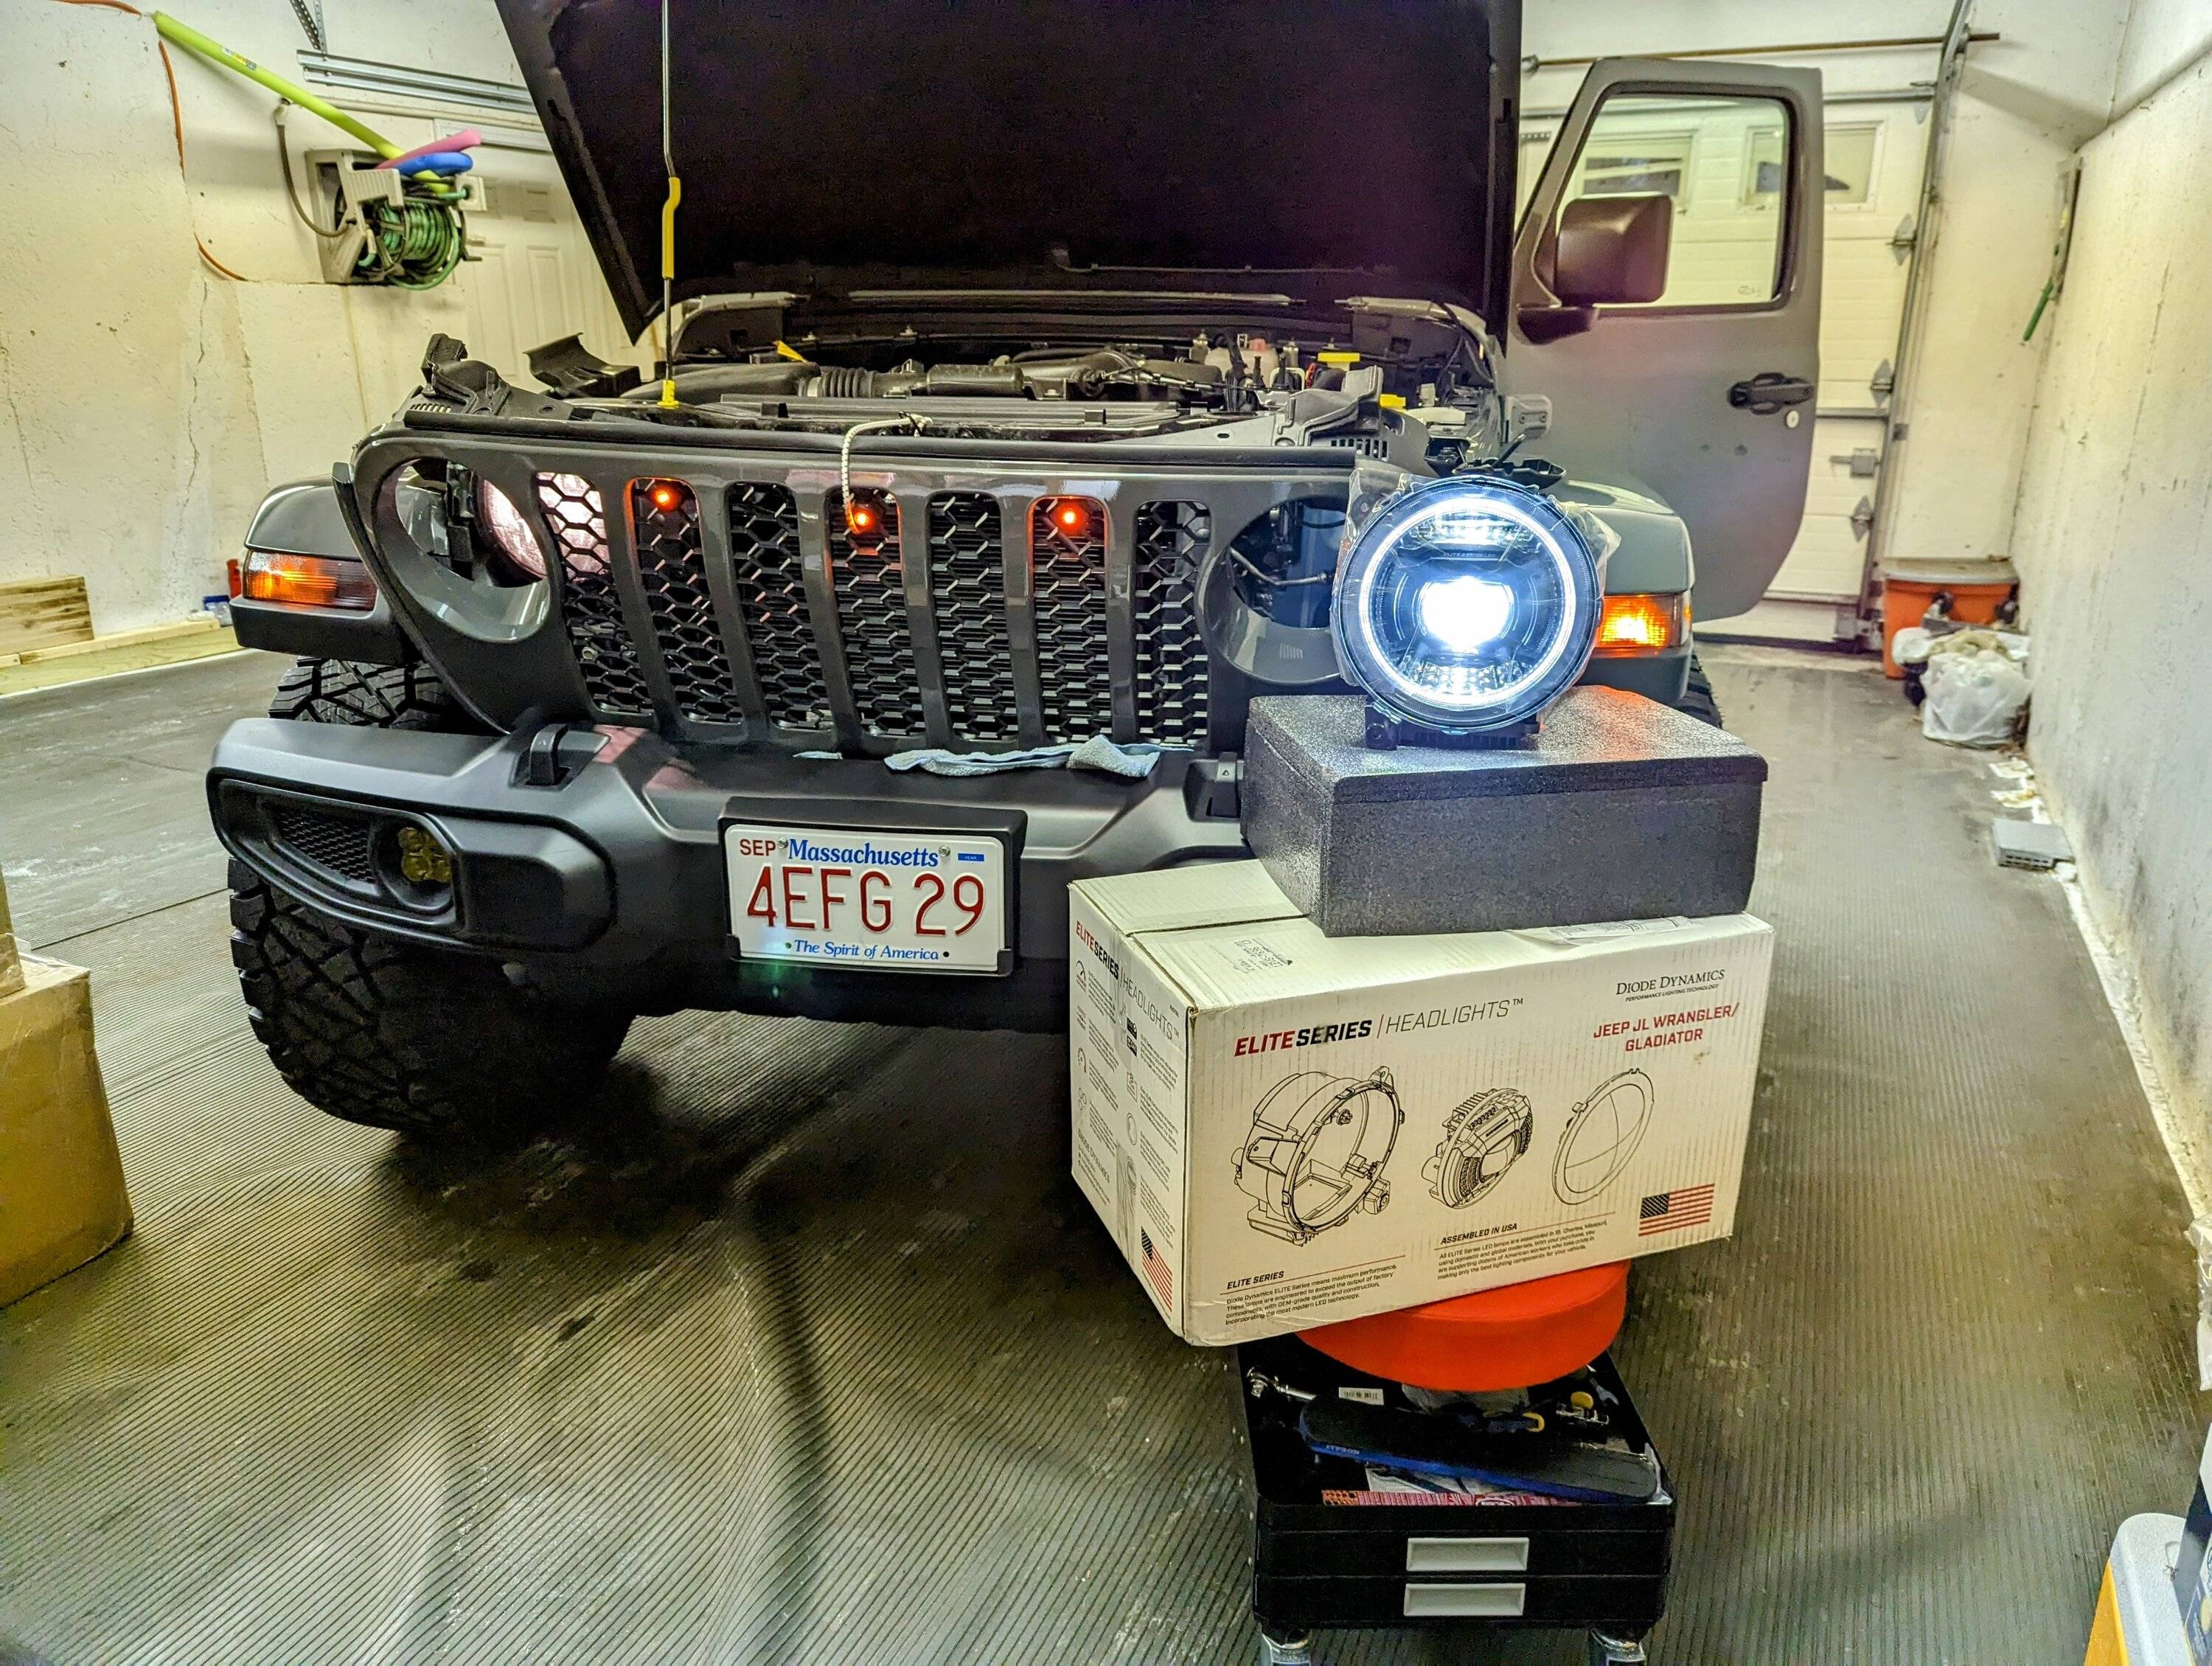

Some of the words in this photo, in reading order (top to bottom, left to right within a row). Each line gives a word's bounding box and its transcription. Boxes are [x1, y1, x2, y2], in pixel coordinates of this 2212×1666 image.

[740, 839, 776, 856] SEP
[788, 839, 939, 867] Massachusetts
[747, 865, 892, 933] 4EFG
[914, 872, 984, 936] 29
[794, 940, 820, 954] The
[824, 941, 860, 959] Spirit
[863, 945, 876, 960] of
[880, 945, 939, 960] America
[1077, 920, 1119, 981] ELITESERIES
[1616, 980, 1657, 995] DIODE
[1660, 969, 1725, 988] DYNAMICS
[1625, 992, 1661, 1002] PERFORMANCE
[1662, 988, 1686, 996] LIGHTING
[1686, 984, 1719, 993] TECHNOLOGY
[1593, 1021, 1630, 1039] JEEP
[1633, 1018, 1649, 1032] JL
[1654, 1002, 1740, 1029] WRANGLER/
[1625, 1028, 1703, 1052] GLADIATOR
[1440, 1228, 1489, 1244] ASSEMBLED
[1501, 1223, 1517, 1232] USA
[1439, 1258, 1453, 1266] using
[1455, 1253, 1478, 1263] domestic
[1491, 1247, 1506, 1255] global
[1448, 1260, 1477, 1271] supporting
[1227, 1277, 1251, 1289] ELITE
[1253, 1270, 1284, 1283] SERIES
[1438, 1271, 1457, 1280] making
[1493, 1260, 1512, 1268] lighting
[1227, 1296, 1242, 1304] Diode
[1245, 1289, 1273, 1301] Dynamics
[1274, 1285, 1290, 1294] ELITE
[1292, 1282, 1310, 1290] Series
[1311, 1277, 1329, 1286] means
[1332, 1271, 1358, 1282] maximum
[1227, 1302, 1244, 1311] These
[1245, 1299, 1262, 1308] lamps
[1275, 1289, 1306, 1301] engineered
[1315, 1283, 1335, 1292] exceed
[1346, 1277, 1364, 1285] output
[1373, 1271, 1393, 1280] factory
[1278, 1296, 1310, 1308] OEM-grade
[1311, 1291, 1329, 1300] quality
[1292, 1302, 1313, 1311] modern
